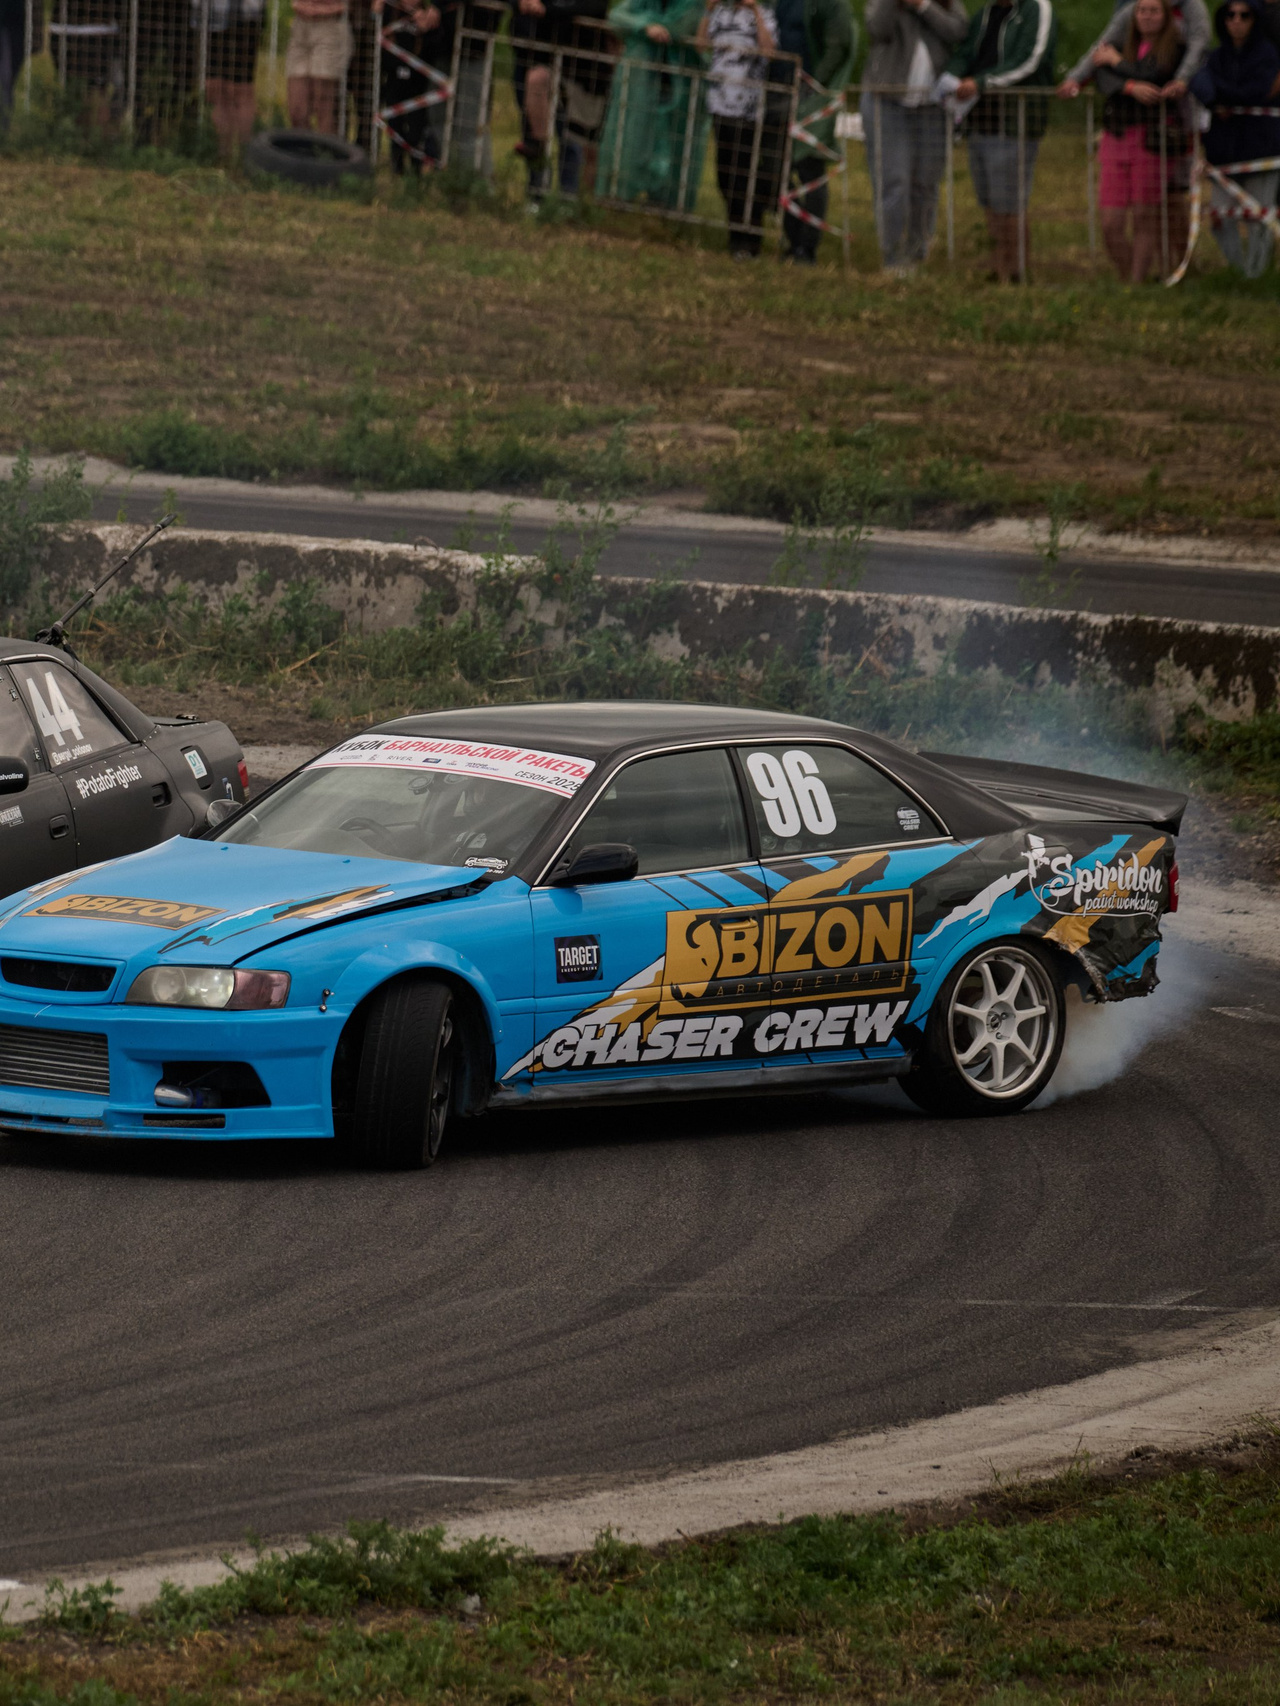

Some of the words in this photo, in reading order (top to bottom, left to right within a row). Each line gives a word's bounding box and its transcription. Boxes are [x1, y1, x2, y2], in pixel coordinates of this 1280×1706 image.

[26, 671, 84, 747] 44
[331, 740, 390, 753] КУБОК
[383, 740, 521, 762] БАРНАУЛЬСКОЙ
[76, 764, 142, 799] #PotatoFighter
[514, 770, 550, 782] СЕЗОН
[746, 750, 837, 837] 96
[1046, 852, 1163, 906] Spiridon
[71, 897, 213, 922] BIZON
[1083, 891, 1117, 917] paint
[1117, 892, 1159, 918] workshop
[558, 945, 599, 967] TARGET
[716, 901, 904, 979] BIZON
[542, 1015, 744, 1068] CHASER
[753, 1000, 910, 1053] CREW
